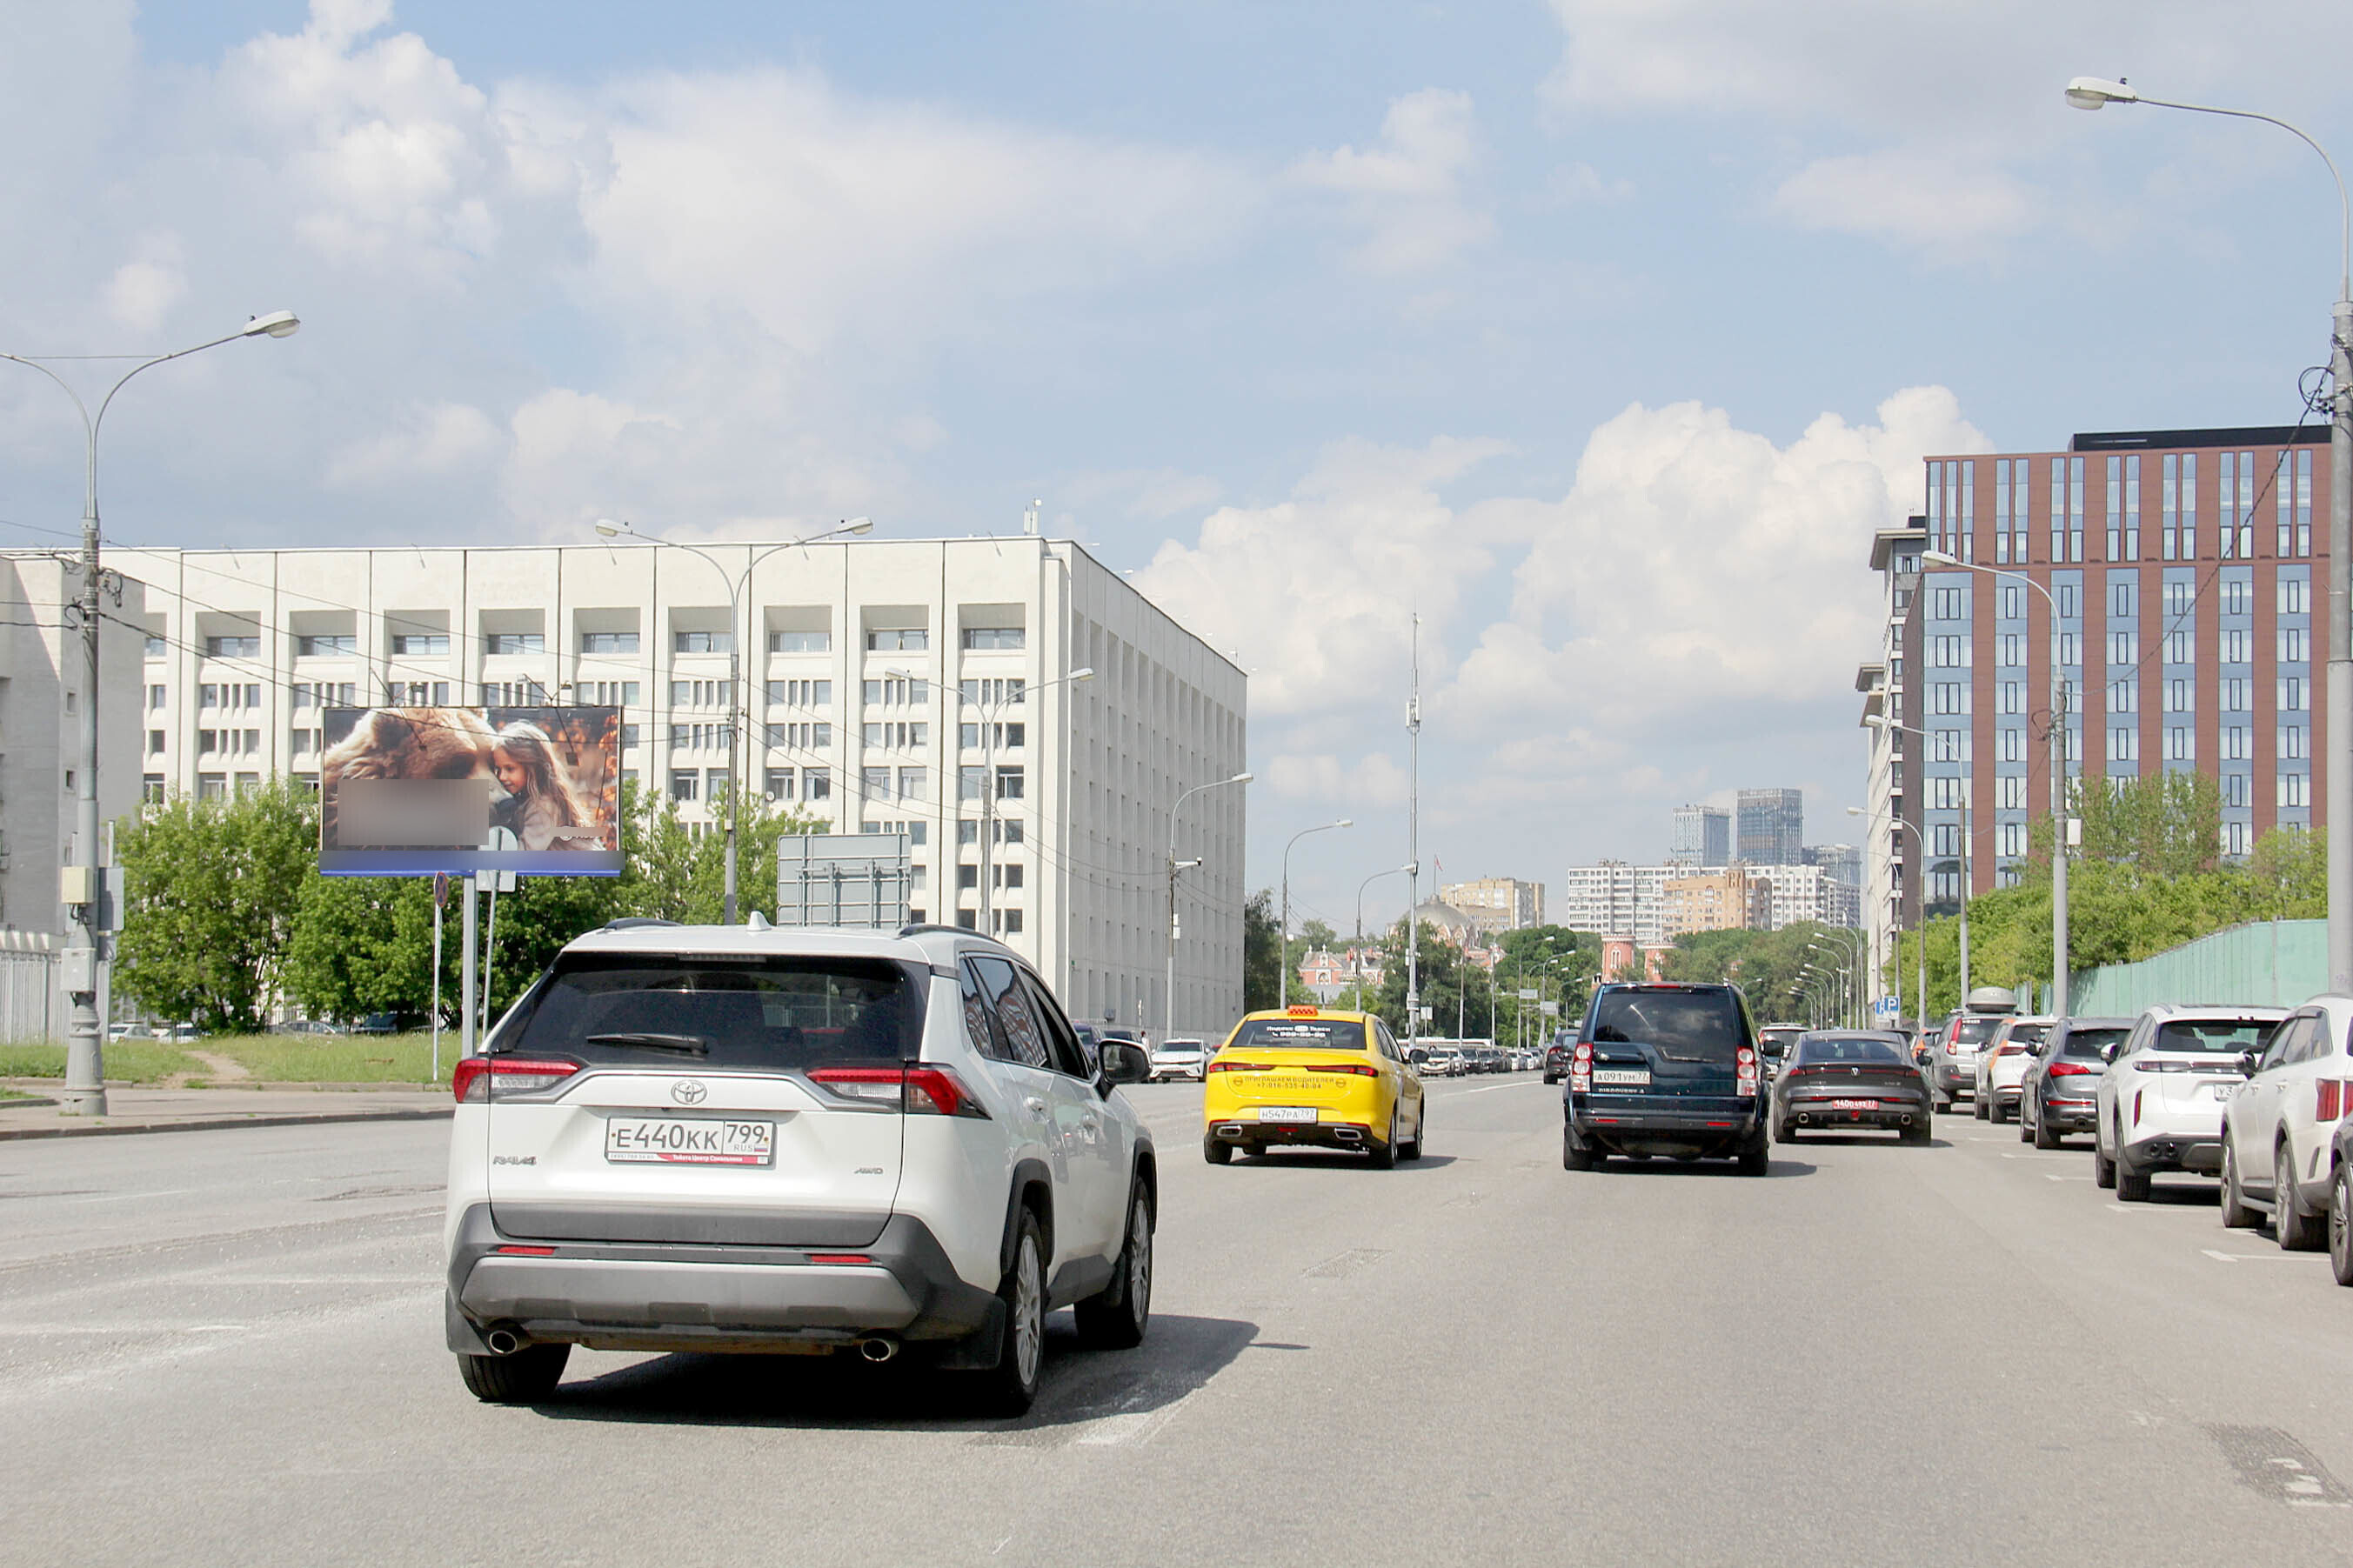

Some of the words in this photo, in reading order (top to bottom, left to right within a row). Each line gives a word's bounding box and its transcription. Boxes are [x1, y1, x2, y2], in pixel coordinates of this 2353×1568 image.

[1888, 998, 1897, 1010] P
[616, 1123, 719, 1150] Е440КК
[726, 1124, 765, 1144] 799
[733, 1144, 754, 1153] RUS
